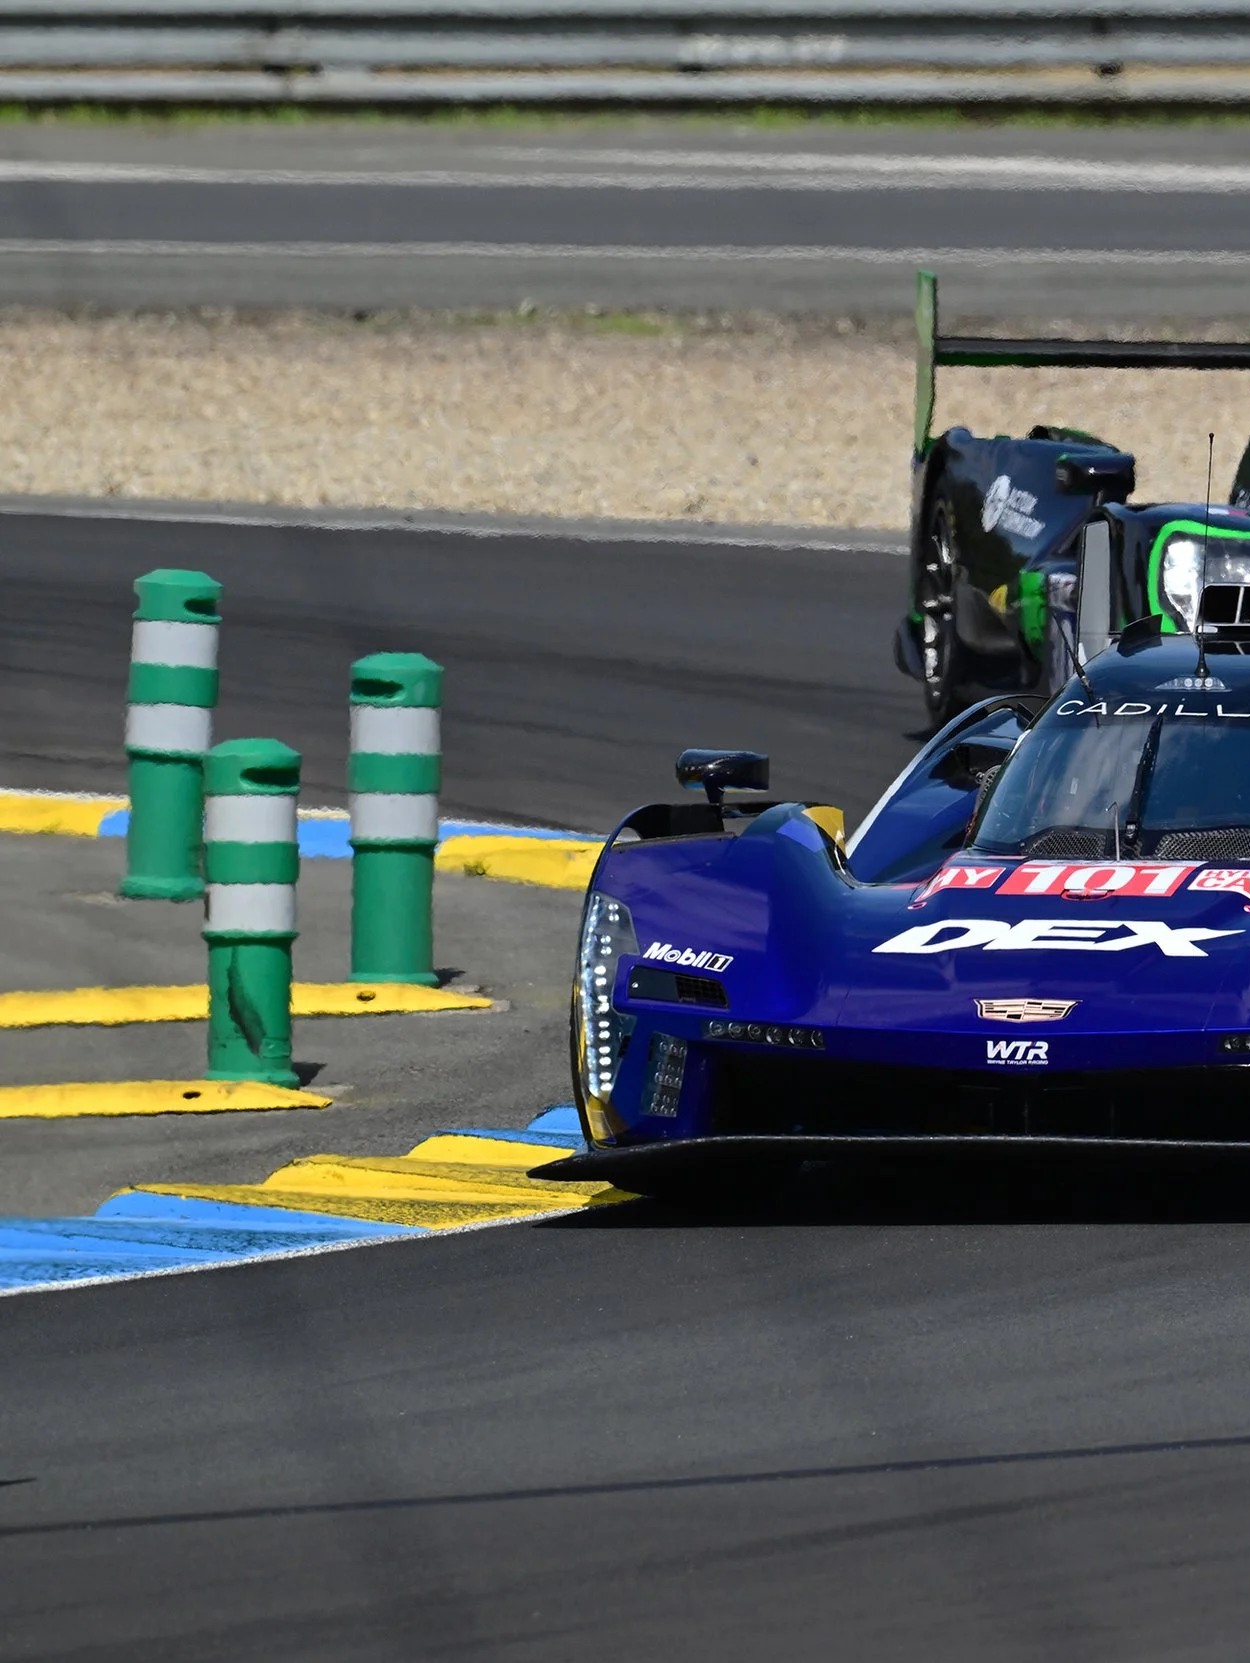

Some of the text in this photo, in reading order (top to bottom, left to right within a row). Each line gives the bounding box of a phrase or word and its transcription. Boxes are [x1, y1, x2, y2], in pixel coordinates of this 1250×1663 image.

[1010, 866, 1187, 894] 101
[871, 919, 1246, 957] DEX
[643, 941, 713, 969] Mobil
[986, 1040, 1048, 1060] WTR
